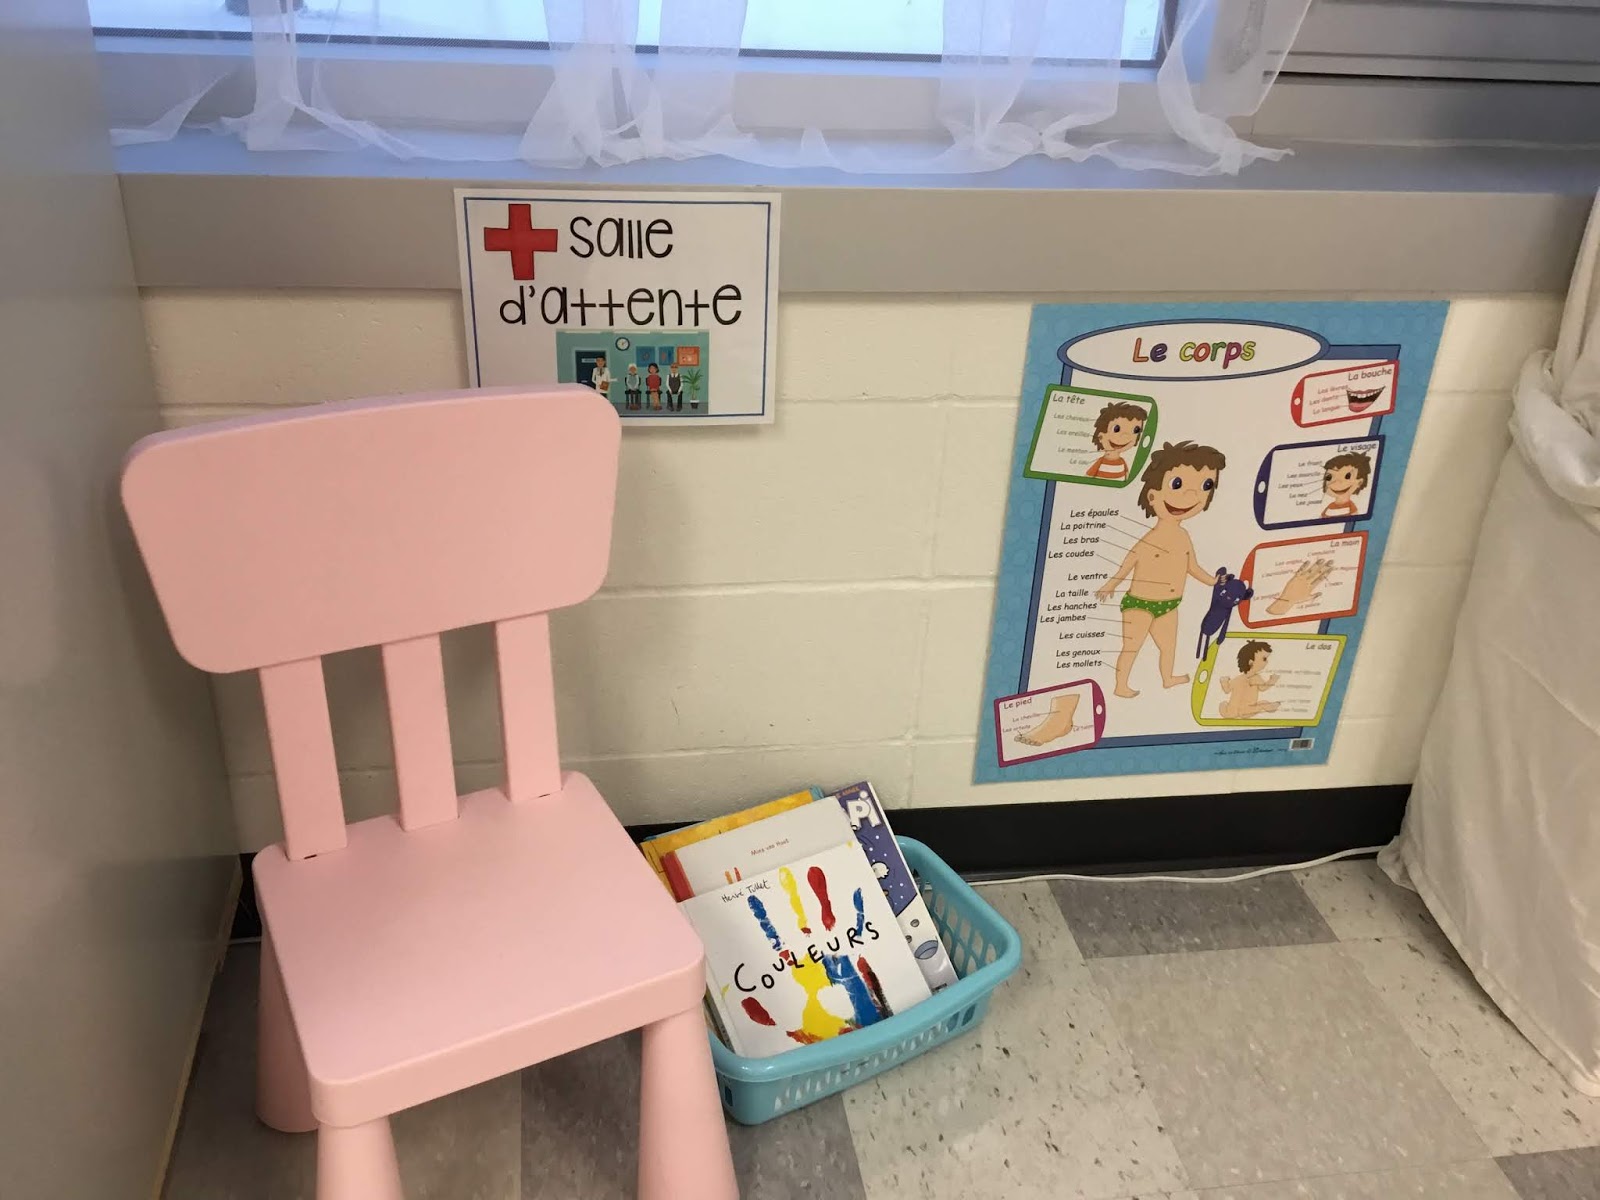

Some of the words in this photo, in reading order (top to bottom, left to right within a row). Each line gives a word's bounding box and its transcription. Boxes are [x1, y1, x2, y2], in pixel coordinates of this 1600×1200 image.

[570, 216, 673, 258] salle
[500, 284, 742, 326] d'attente
[1133, 338, 1167, 363] Le
[1179, 339, 1256, 369] corps
[1348, 372, 1359, 381] La
[1361, 367, 1392, 379] bouche
[1052, 393, 1063, 403] La
[1066, 394, 1085, 405] tête
[1337, 445, 1348, 453] Le
[1350, 443, 1377, 453] visage
[1087, 508, 1119, 518] épaules
[1060, 522, 1070, 530] La
[1072, 521, 1106, 531] poitrine
[1063, 536, 1078, 544] Les
[1080, 536, 1099, 544] bras
[1065, 549, 1094, 558] coudes
[1080, 572, 1108, 580] ventre
[1068, 589, 1089, 597] taille
[1047, 603, 1062, 611] Les
[1064, 602, 1097, 610] hanches
[1040, 615, 1055, 623] Les
[1056, 614, 1087, 624] jambes
[1059, 631, 1074, 639] Les
[1305, 642, 1315, 650] Le
[1056, 649, 1070, 657] Les
[1072, 649, 1101, 658] genoux
[1073, 660, 1102, 668] mollets
[1003, 701, 1014, 710] Le
[1016, 697, 1033, 708] pied
